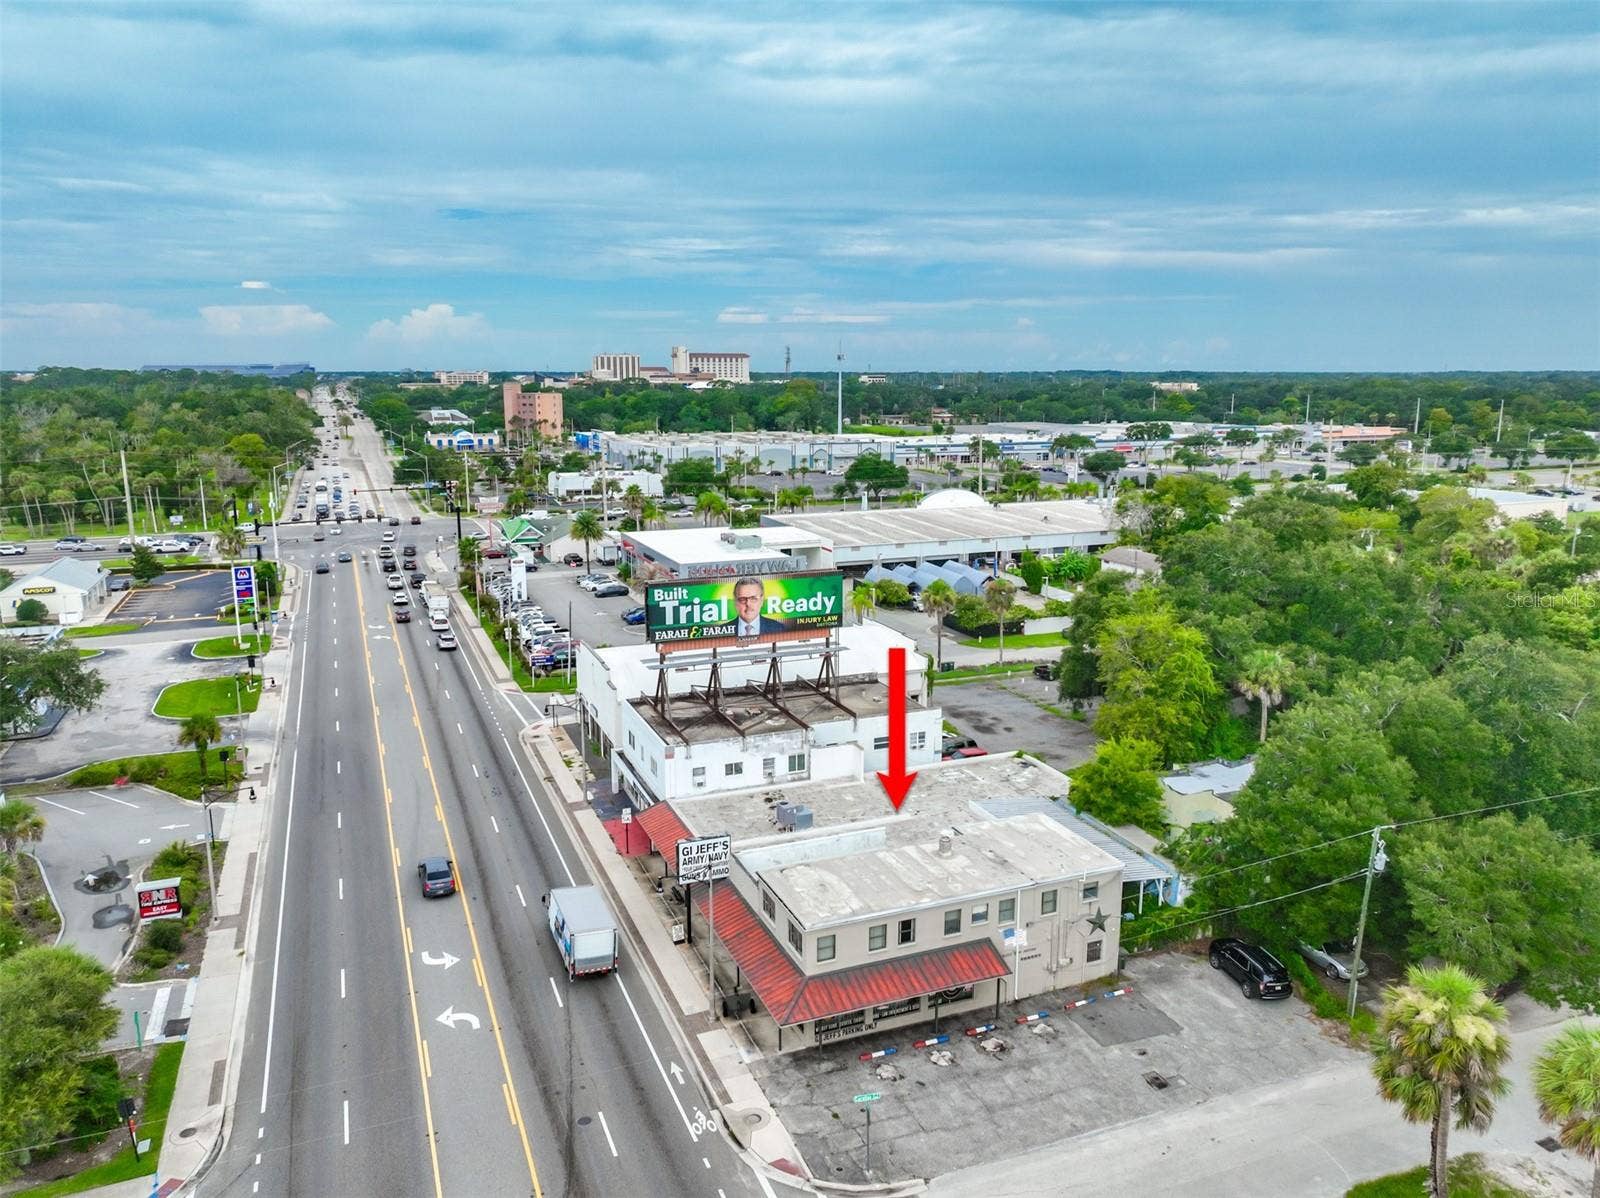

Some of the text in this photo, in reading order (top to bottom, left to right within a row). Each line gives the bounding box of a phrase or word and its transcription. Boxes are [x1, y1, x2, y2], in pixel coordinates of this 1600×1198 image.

[654, 587, 688, 601] Built
[659, 592, 836, 625] Trial Ready
[797, 616, 822, 624] INJURY
[655, 629, 689, 640] FARAH
[703, 625, 736, 636] FARAH
[682, 841, 728, 856] GI JEFF'S
[682, 851, 729, 866] ARMY/NAVY
[709, 867, 729, 876] MMO
[842, 1026, 864, 1037] PARKING
[864, 1021, 878, 1031] ONLY
